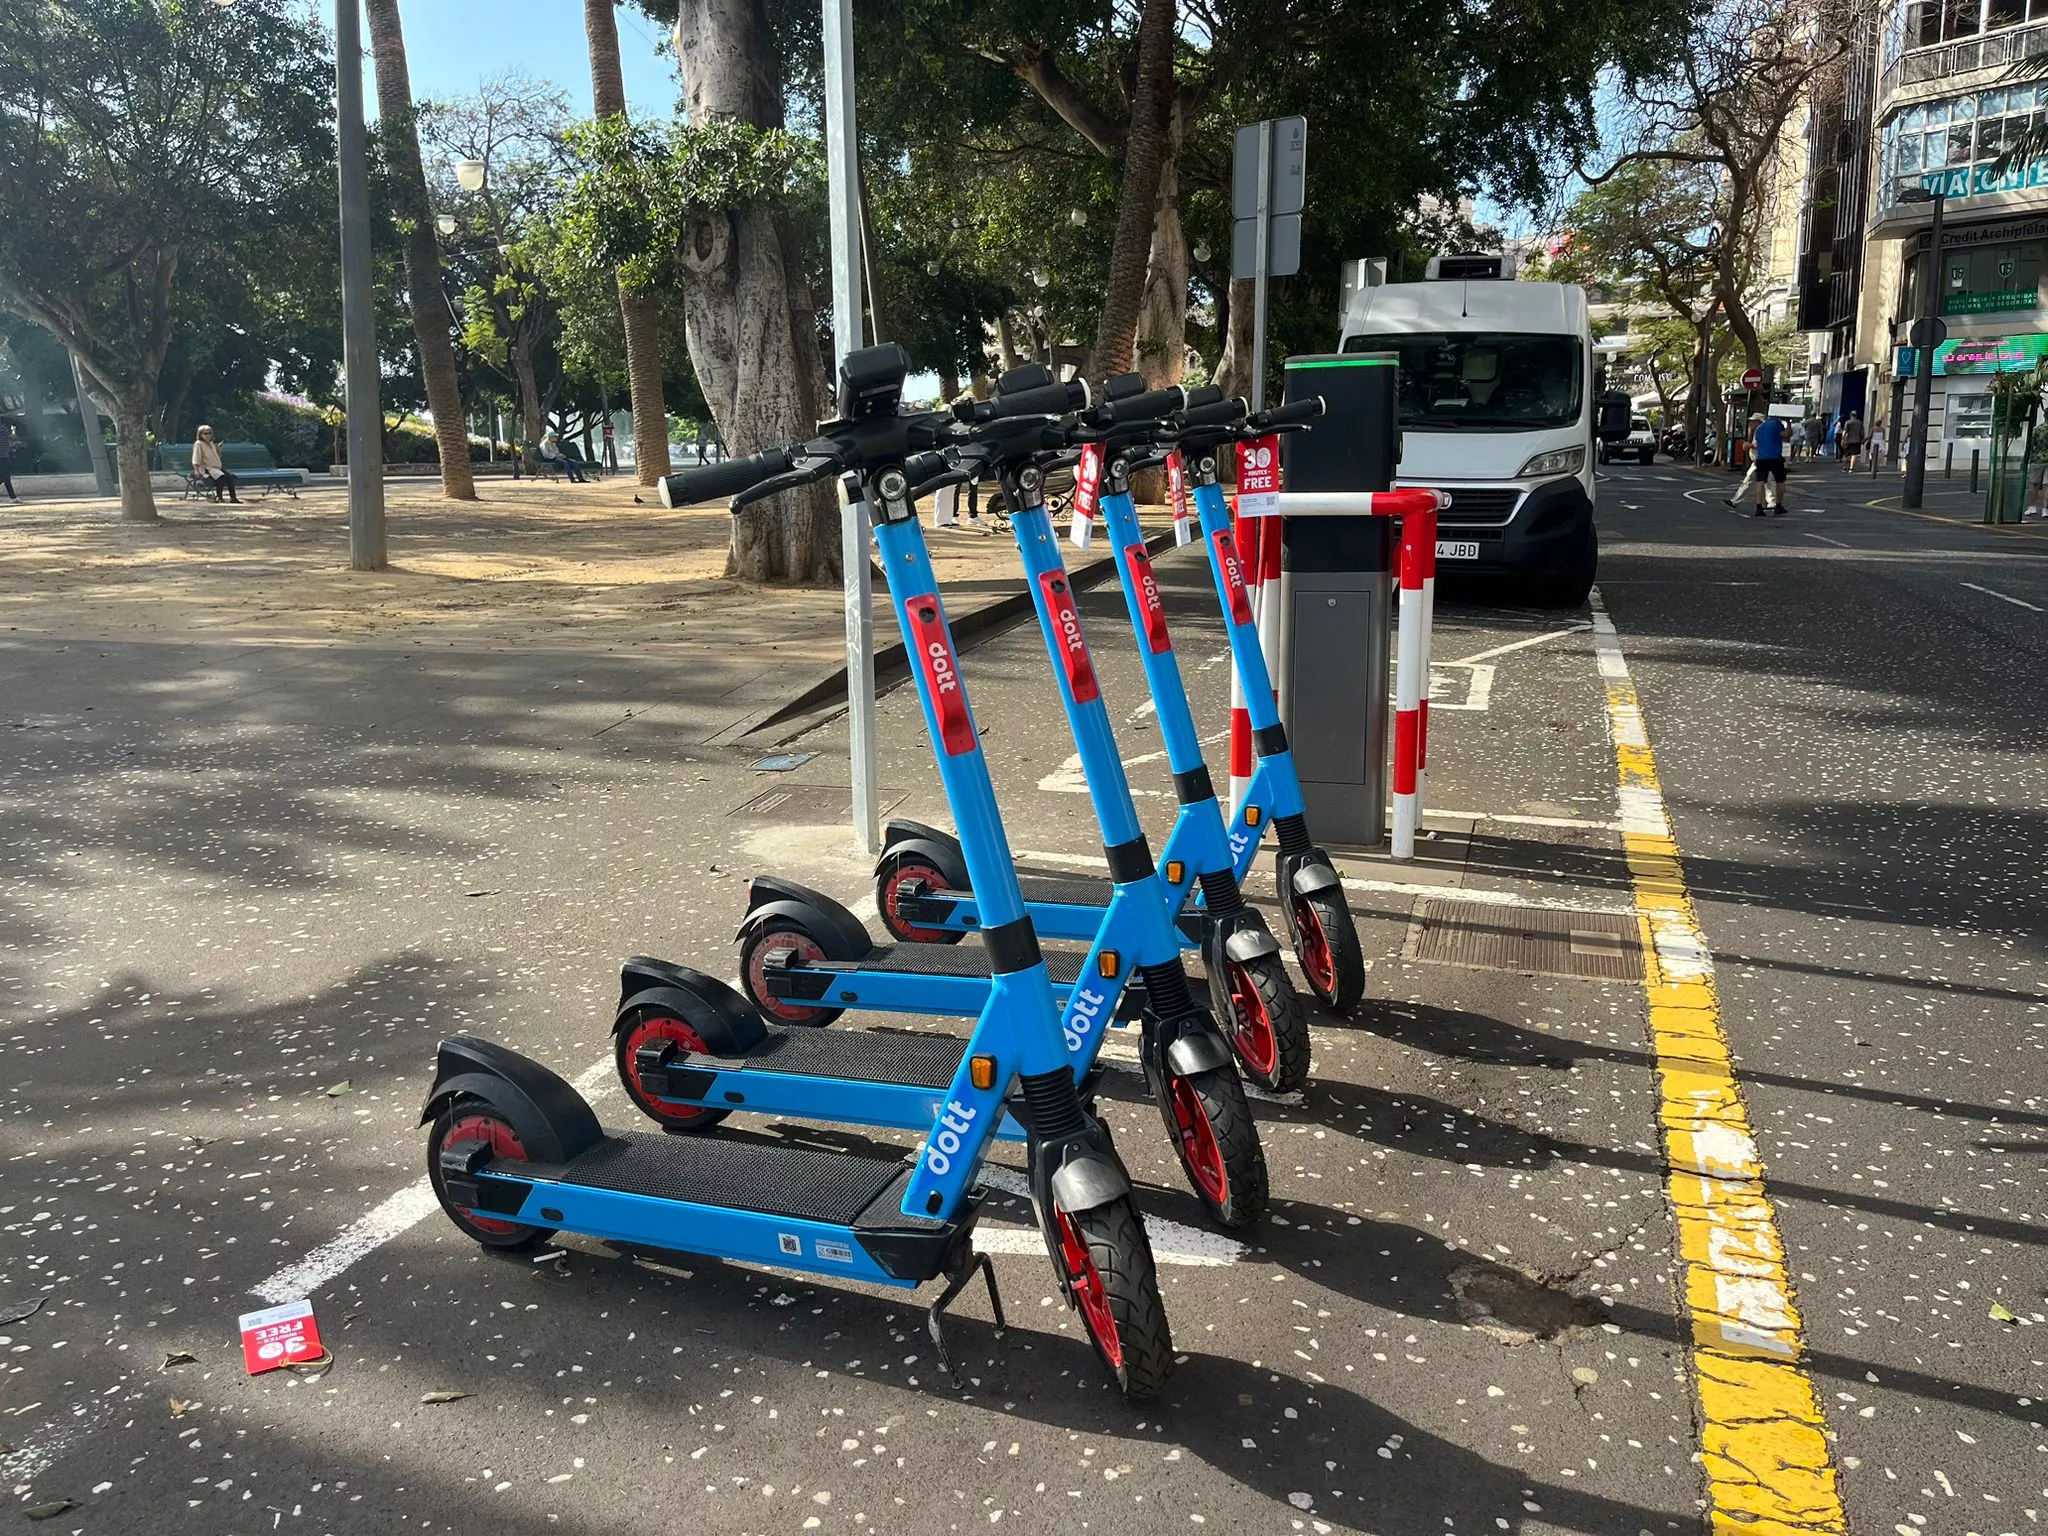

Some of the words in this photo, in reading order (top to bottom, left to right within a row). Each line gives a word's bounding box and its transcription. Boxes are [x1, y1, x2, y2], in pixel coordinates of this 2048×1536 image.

[1941, 231, 1978, 244] Credit
[1243, 447, 1272, 470] 30
[1243, 476, 1272, 490] FREE
[1449, 544, 1477, 557] JBD
[1226, 557, 1242, 588] dott
[1142, 576, 1161, 611] dott
[1060, 609, 1083, 652] dott
[928, 642, 956, 694] dott
[926, 1100, 977, 1175] dott
[255, 1320, 304, 1341] FREE
[258, 1335, 308, 1360] 30
